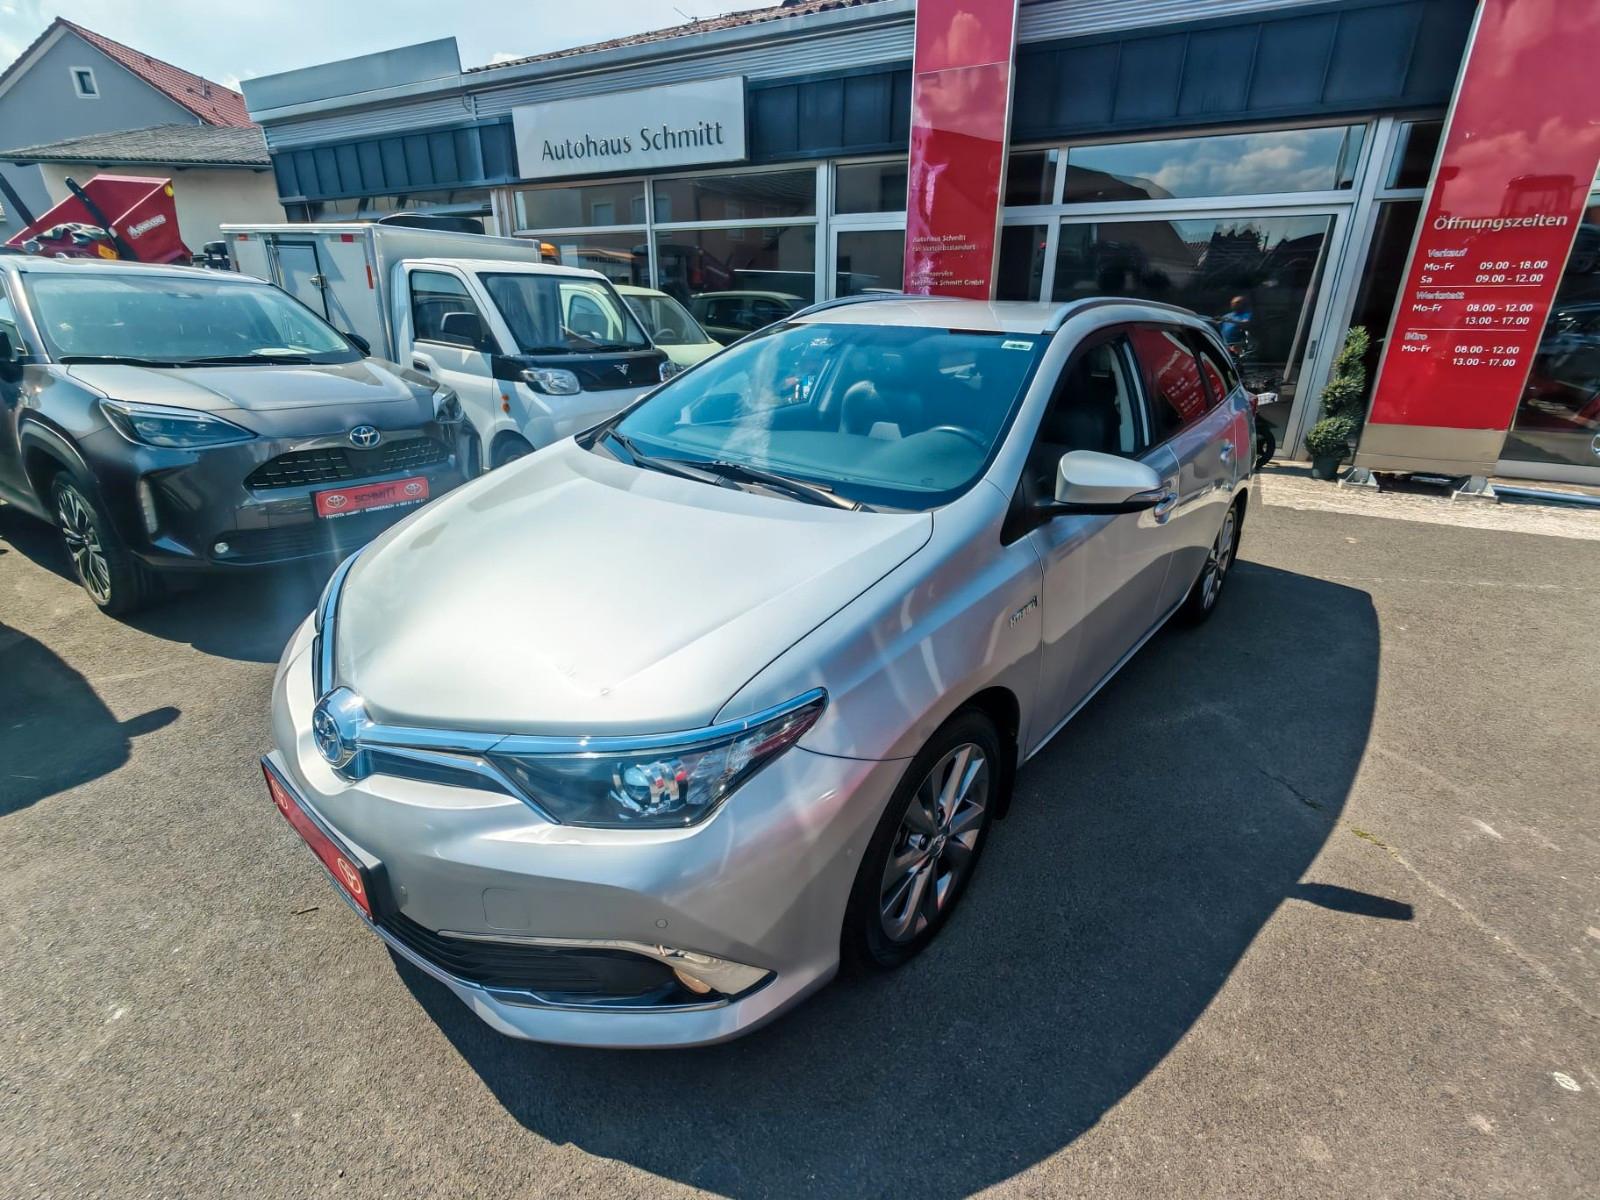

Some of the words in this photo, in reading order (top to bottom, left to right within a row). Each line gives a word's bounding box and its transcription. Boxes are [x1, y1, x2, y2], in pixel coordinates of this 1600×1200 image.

[542, 132, 631, 161] Autohaus
[640, 121, 723, 151] Schmitt
[1433, 214, 1568, 232] Öffnungszeiten
[1428, 248, 1468, 258] Verkauf
[1424, 263, 1455, 271] Mo-Fr
[1479, 261, 1509, 270] 09.00
[1519, 260, 1548, 269] 18.00
[1420, 275, 1433, 284] Sa
[1475, 274, 1505, 283] 09.00
[1515, 273, 1544, 283] 12.00
[1416, 291, 1465, 300] Werkstatt
[1412, 304, 1442, 312] Mo-Fr
[1466, 304, 1496, 312] 08.00
[1505, 304, 1533, 312] 12.00
[1465, 317, 1492, 325] 13.00
[1502, 317, 1530, 325] 17.00
[1404, 332, 1428, 341] Büro
[1401, 344, 1431, 353] Mo-Fr
[1454, 345, 1483, 354] 08.00
[1493, 346, 1520, 354] 12.00
[1452, 358, 1479, 366] 13.00
[1488, 358, 1516, 367] 17.00
[354, 486, 396, 502] SCHMITT
